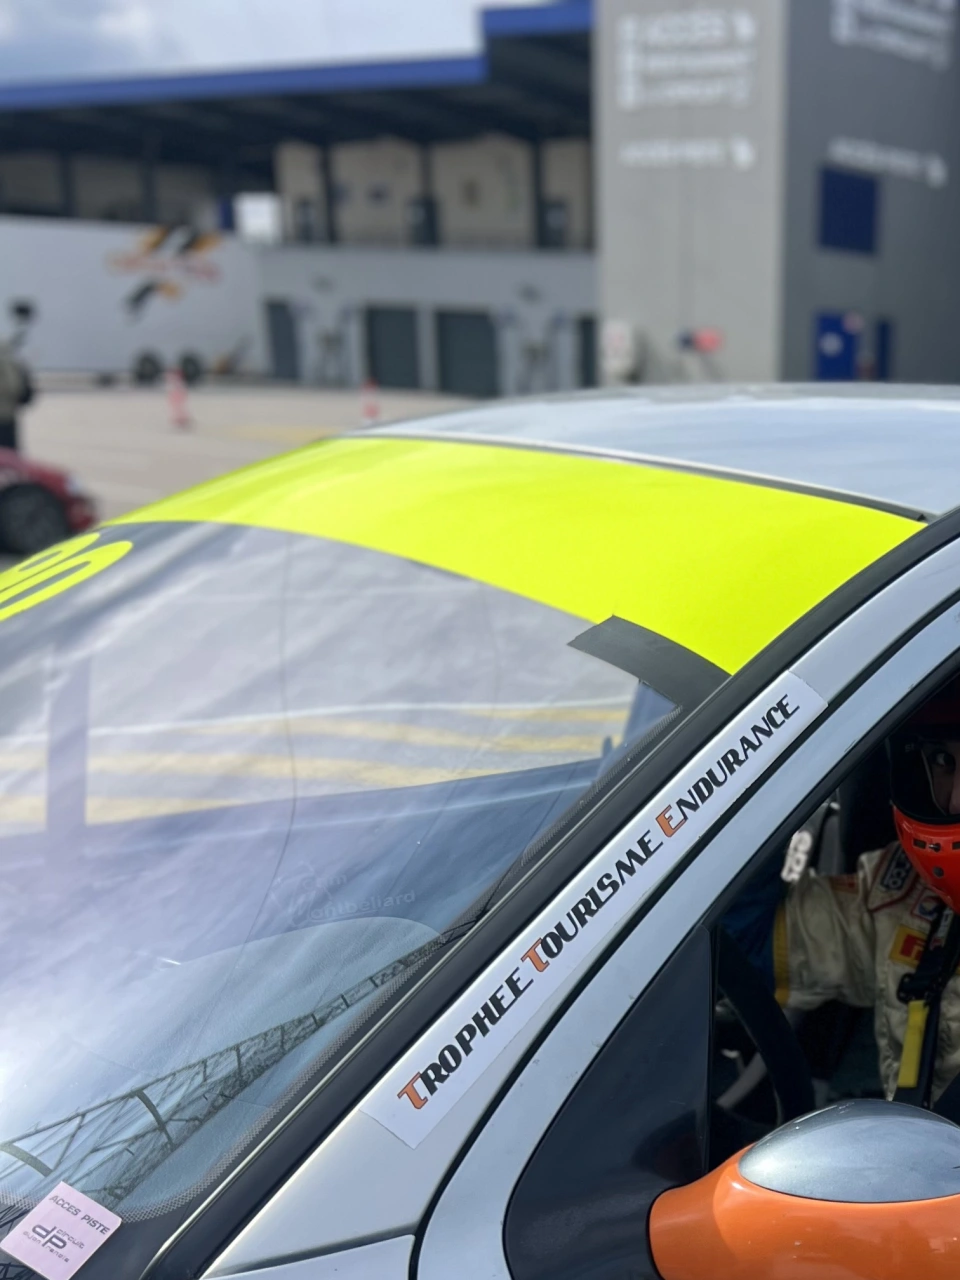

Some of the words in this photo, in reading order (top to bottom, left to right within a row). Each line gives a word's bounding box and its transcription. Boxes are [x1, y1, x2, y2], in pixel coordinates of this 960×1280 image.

[398, 967, 534, 1109] TROPHEE
[521, 830, 663, 972] TOURISME
[656, 694, 800, 838] ENDURANCE
[49, 1195, 81, 1216] ACCES
[81, 1214, 110, 1235] PISTE
